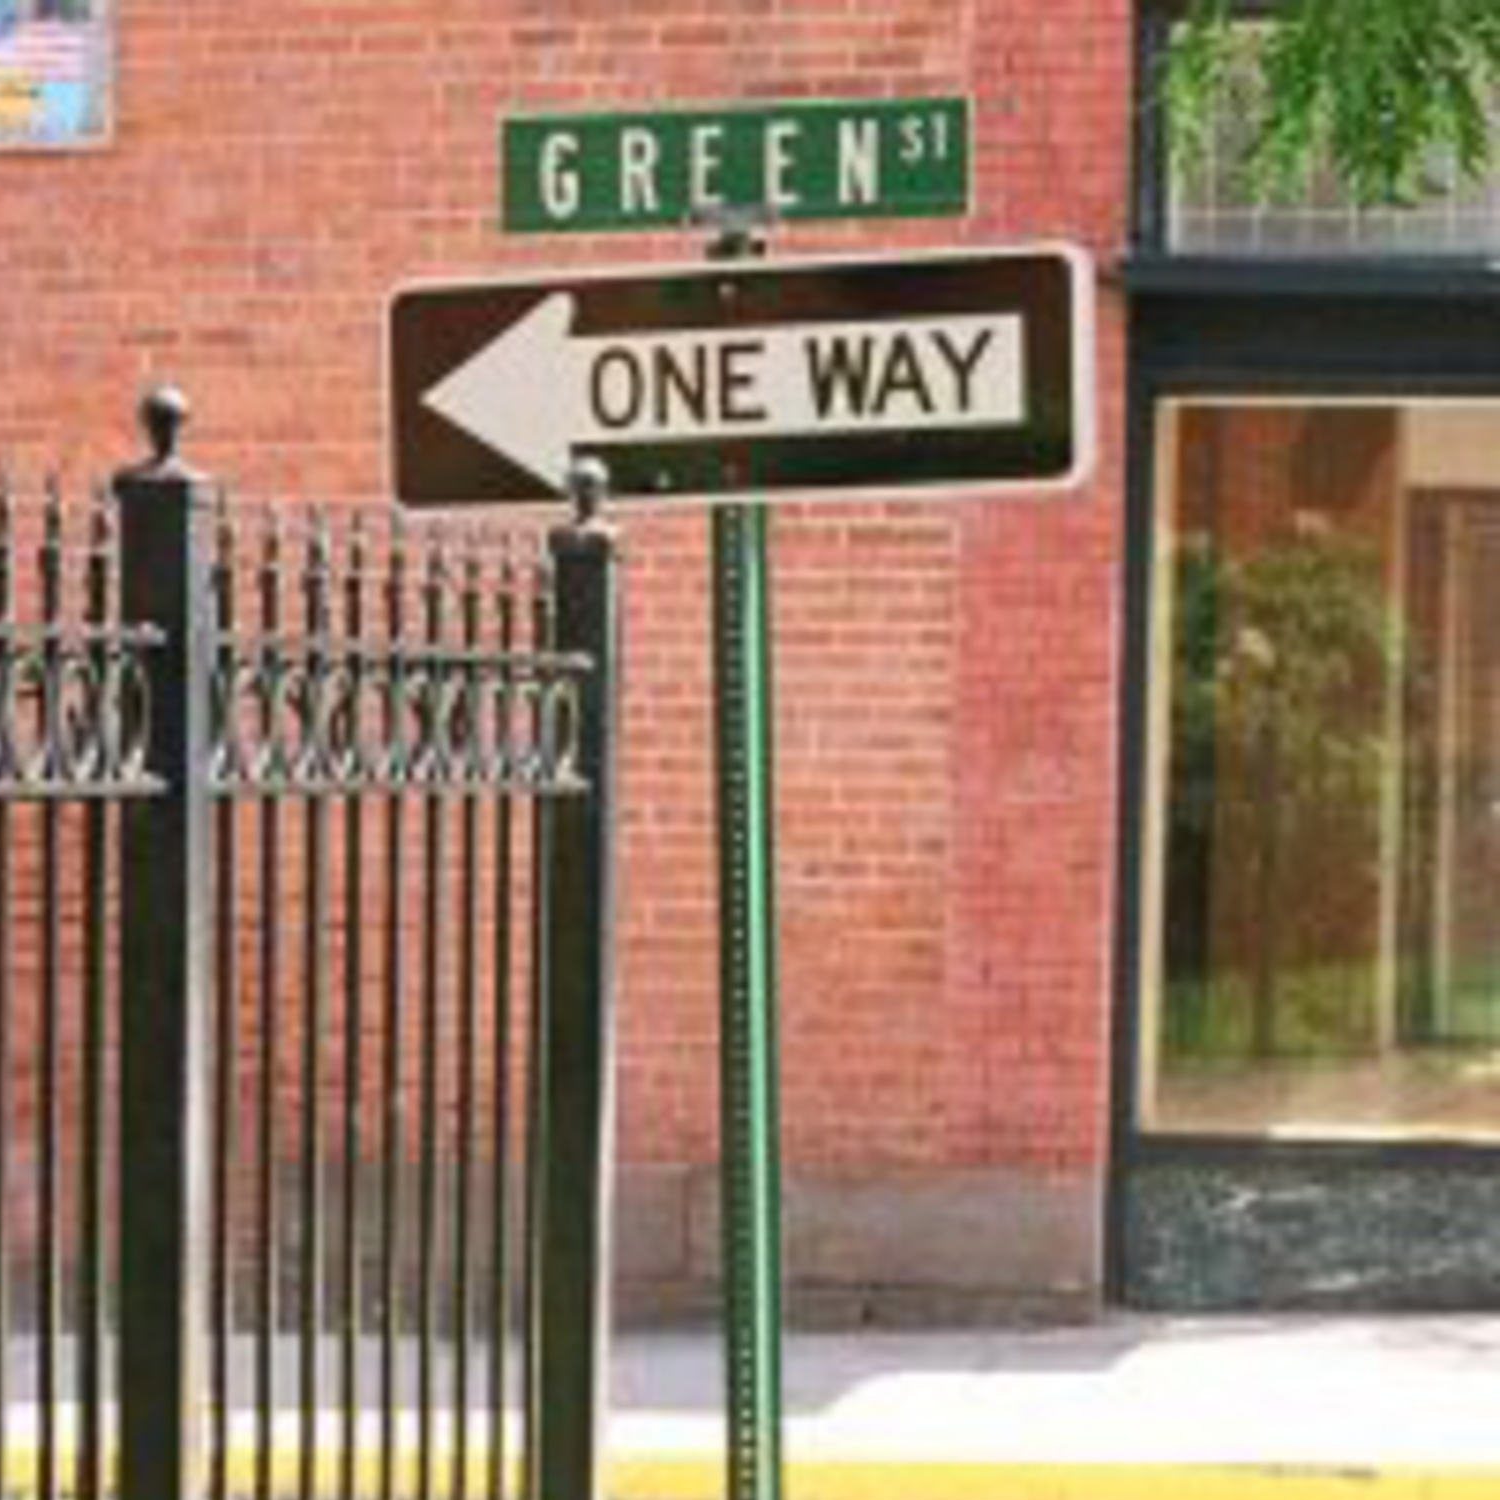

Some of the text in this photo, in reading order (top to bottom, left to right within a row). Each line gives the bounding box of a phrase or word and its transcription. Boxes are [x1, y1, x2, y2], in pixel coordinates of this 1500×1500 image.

[539, 117, 880, 219] GREEN
[590, 328, 993, 428] ONE WAY
